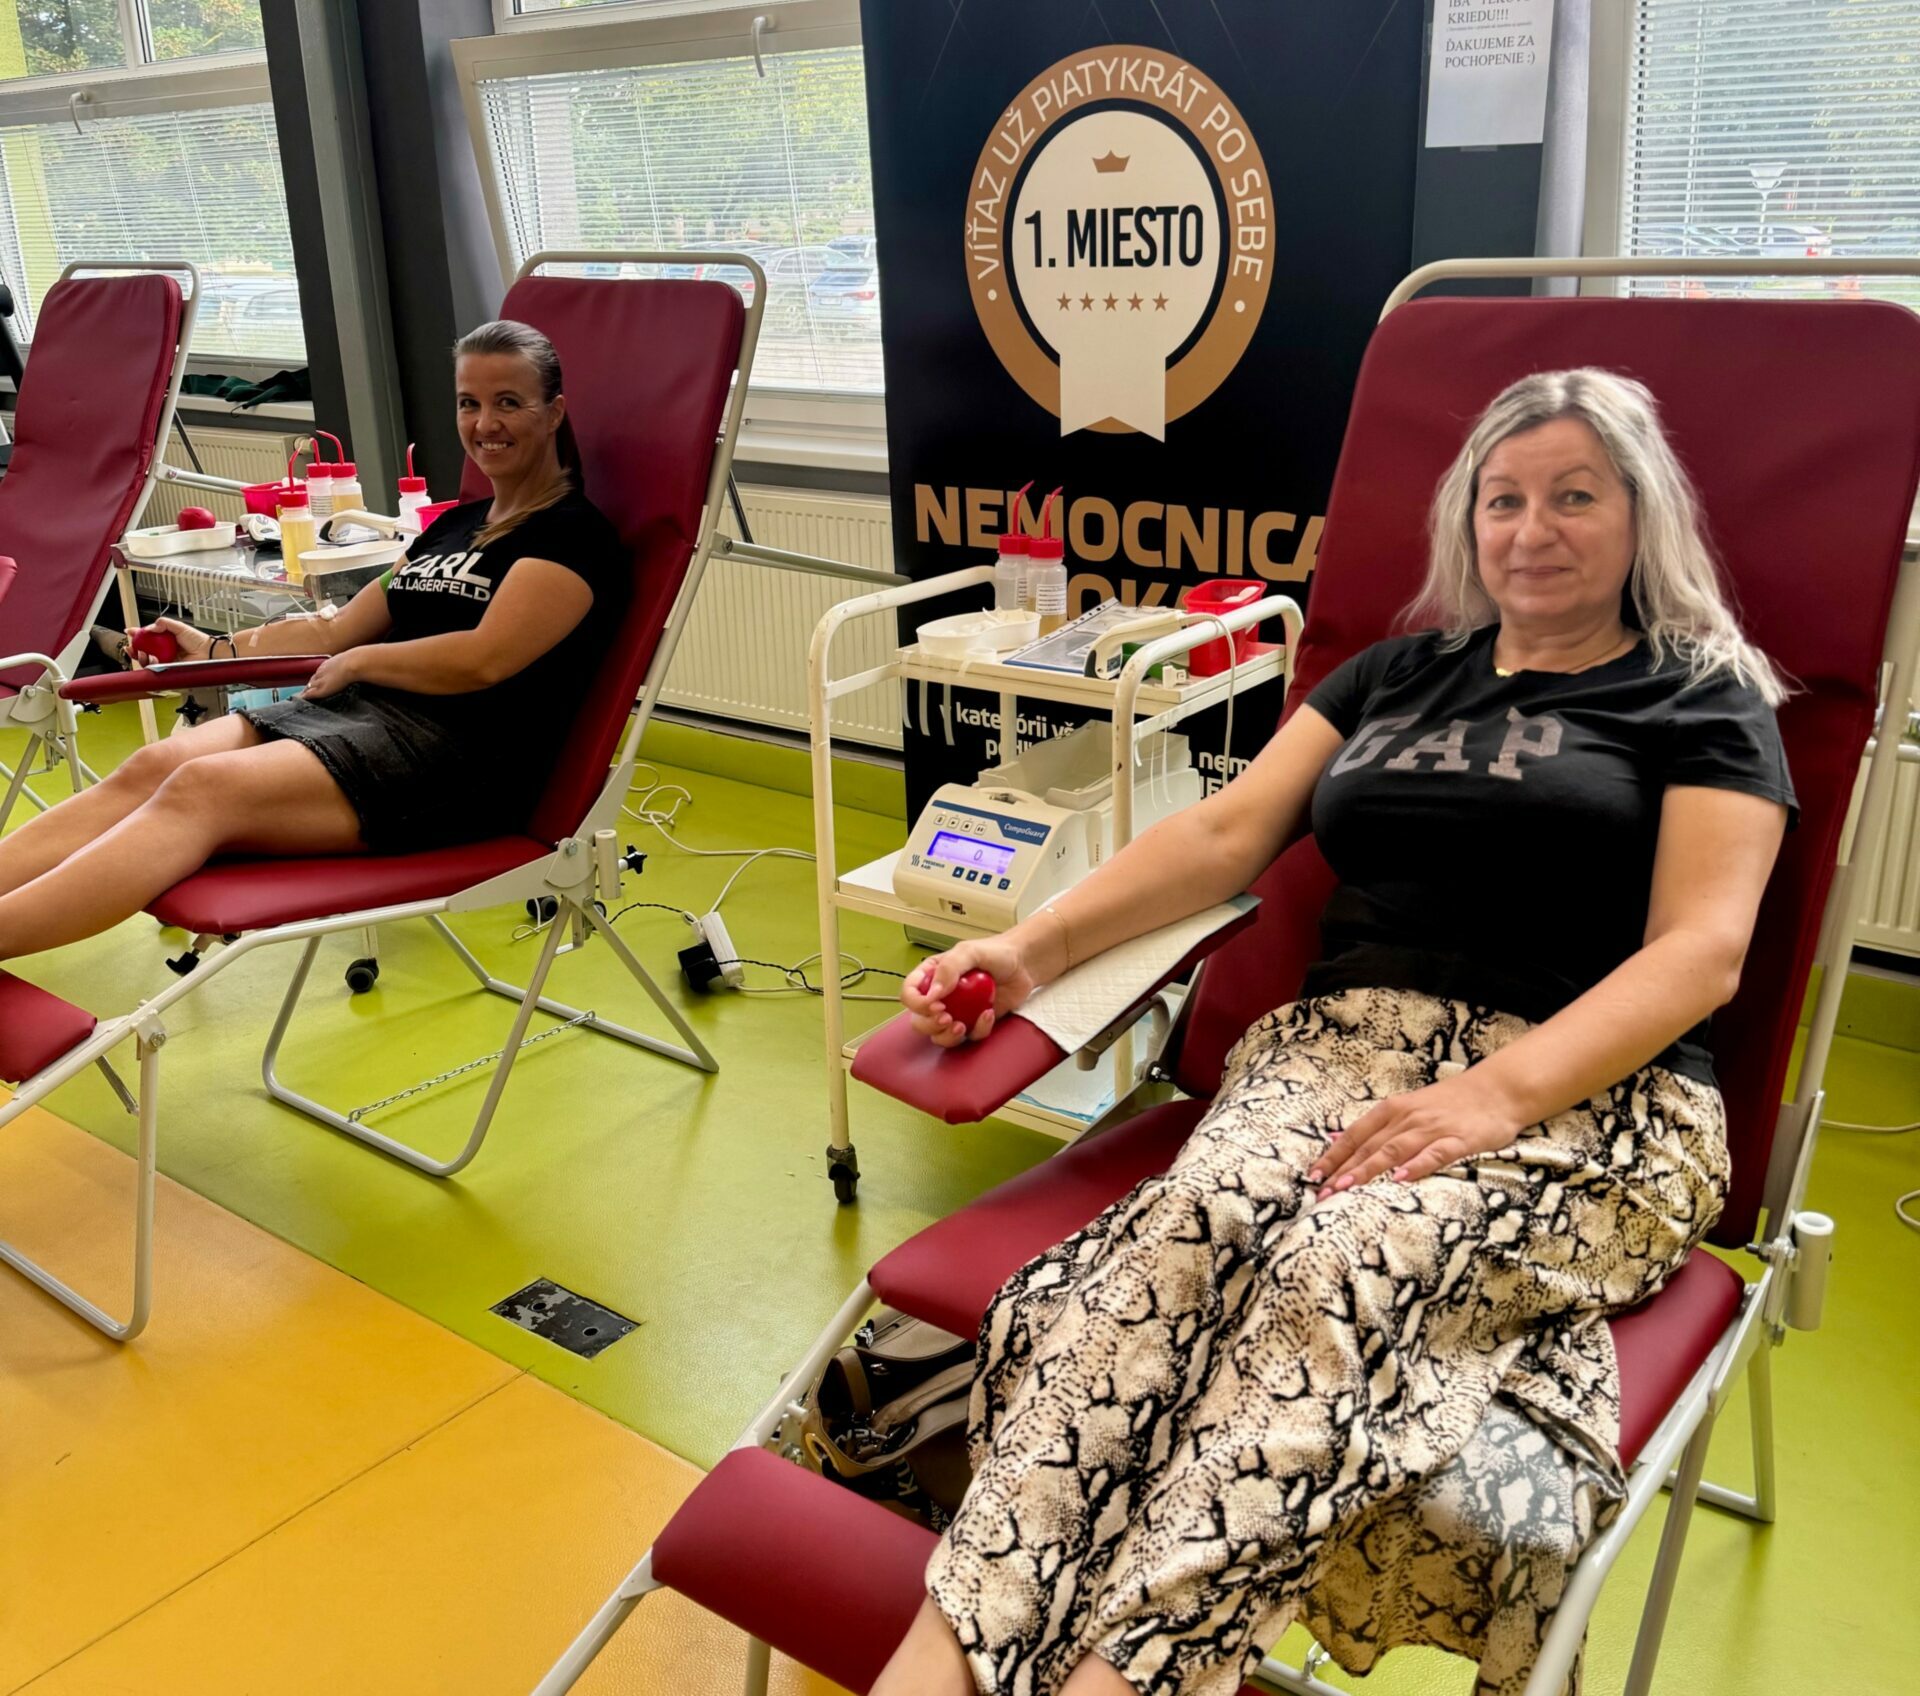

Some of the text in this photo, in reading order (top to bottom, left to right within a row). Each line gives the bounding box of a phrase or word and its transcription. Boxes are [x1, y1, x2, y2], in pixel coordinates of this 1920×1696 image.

[1448, 9, 1509, 25] KRIEDU!!!
[1446, 35, 1535, 52] ĎAKUJEME ZA
[1445, 52, 1524, 69] POCHOPENIE
[967, 57, 1267, 282] VÍŤAZ UŽ PIATYKRÁT PO SEBE
[1024, 204, 1204, 268] 1. MIESTO
[405, 577, 491, 602] LAGERFELD
[956, 702, 1047, 739] kateórii
[1329, 706, 1564, 780] GAP
[1003, 822, 1046, 839] CompoGuard
